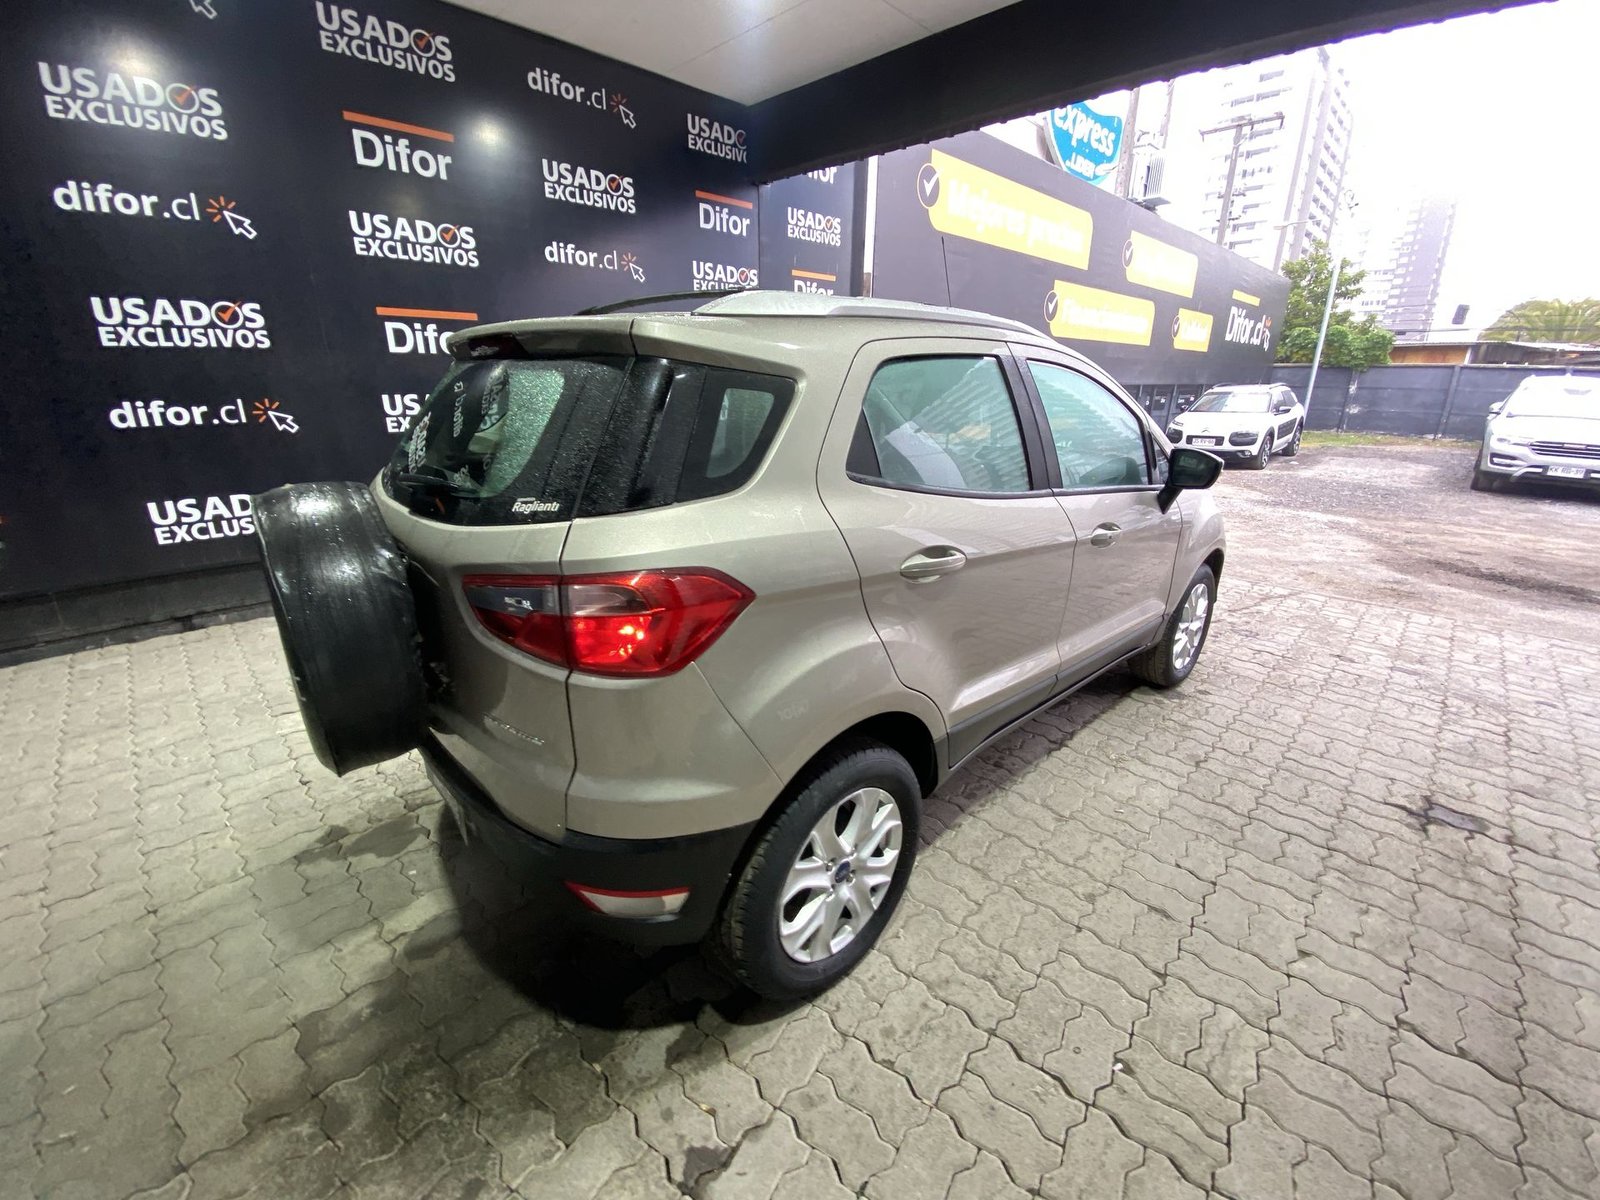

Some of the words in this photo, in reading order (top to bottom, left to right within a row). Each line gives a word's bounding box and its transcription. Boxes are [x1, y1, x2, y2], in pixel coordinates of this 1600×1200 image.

[316, 1, 452, 62] USADOS
[320, 30, 455, 83] EXCLUSIVOS
[38, 61, 223, 117] USADOS
[527, 67, 607, 110] difor.cl
[45, 95, 228, 141] EXCLUSIVOS
[687, 113, 747, 150] USADO
[1054, 106, 1116, 157] express
[351, 128, 452, 181] Difor
[688, 133, 747, 164] EXCLUSIV
[542, 158, 635, 198] USADOS
[53, 180, 200, 221] difor.cl
[544, 181, 637, 214] EXCLUSIVOS
[349, 210, 476, 250] USADOS
[699, 202, 750, 237] Difor
[787, 206, 841, 235] USADOS
[353, 236, 479, 268] EXCLUSIVOS
[787, 229, 841, 247] EXCLUSIVOS
[544, 241, 618, 270] difor.cl
[692, 260, 759, 287] USADOS
[90, 297, 266, 329] USADOS
[98, 325, 271, 349] EXCLUSIVOS
[384, 321, 454, 355] Dif
[109, 398, 247, 429] difor.cl
[146, 493, 252, 526] USAD
[511, 500, 560, 514] Raglianti
[154, 517, 256, 545] EXCLUS
